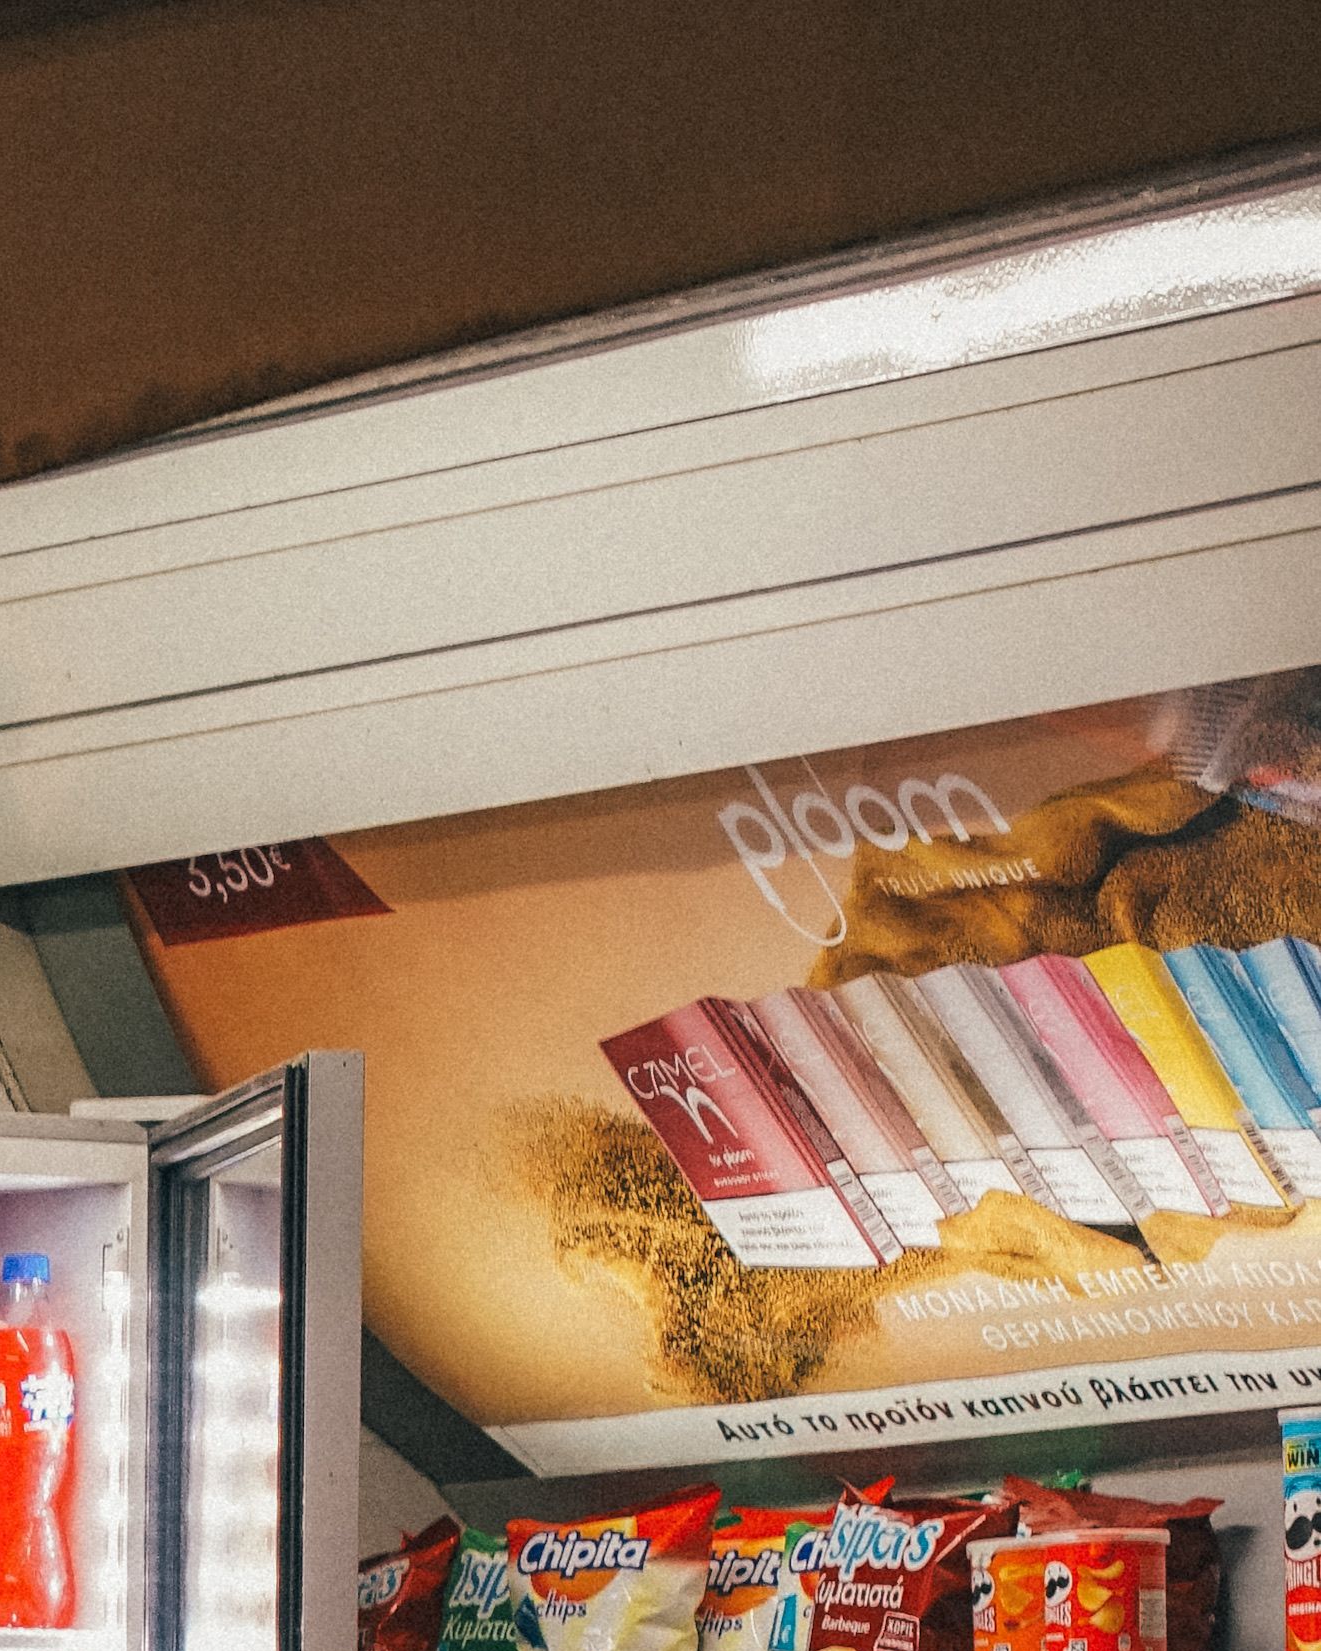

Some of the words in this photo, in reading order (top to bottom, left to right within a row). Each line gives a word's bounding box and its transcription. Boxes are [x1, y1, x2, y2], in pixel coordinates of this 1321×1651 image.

[718, 753, 1014, 947] ploom
[874, 871, 946, 898] TRULY
[950, 856, 1043, 888] UNIQUE
[626, 1043, 737, 1101] CAMEL
[895, 1271, 1073, 1324] ΜΟΝΑΔΙΚΗ
[1078, 1259, 1225, 1299] ΕΜΠΕΙΡΙΑ
[1230, 1257, 1321, 1288] ΑΠΟΛ
[981, 1299, 1254, 1352] ΘΕΡΜΑΙΝΟΜΕΝΟΥ
[716, 1416, 794, 1444] Αυτό
[804, 1410, 839, 1434] το
[845, 1394, 956, 1437] προϊόν
[965, 1378, 1086, 1419] καπνού
[1091, 1370, 1221, 1412] βλάπτει
[1223, 1369, 1279, 1394] την
[517, 1530, 651, 1578] Chipita
[536, 1589, 588, 1625] chips
[821, 1615, 872, 1637] Barbeque
